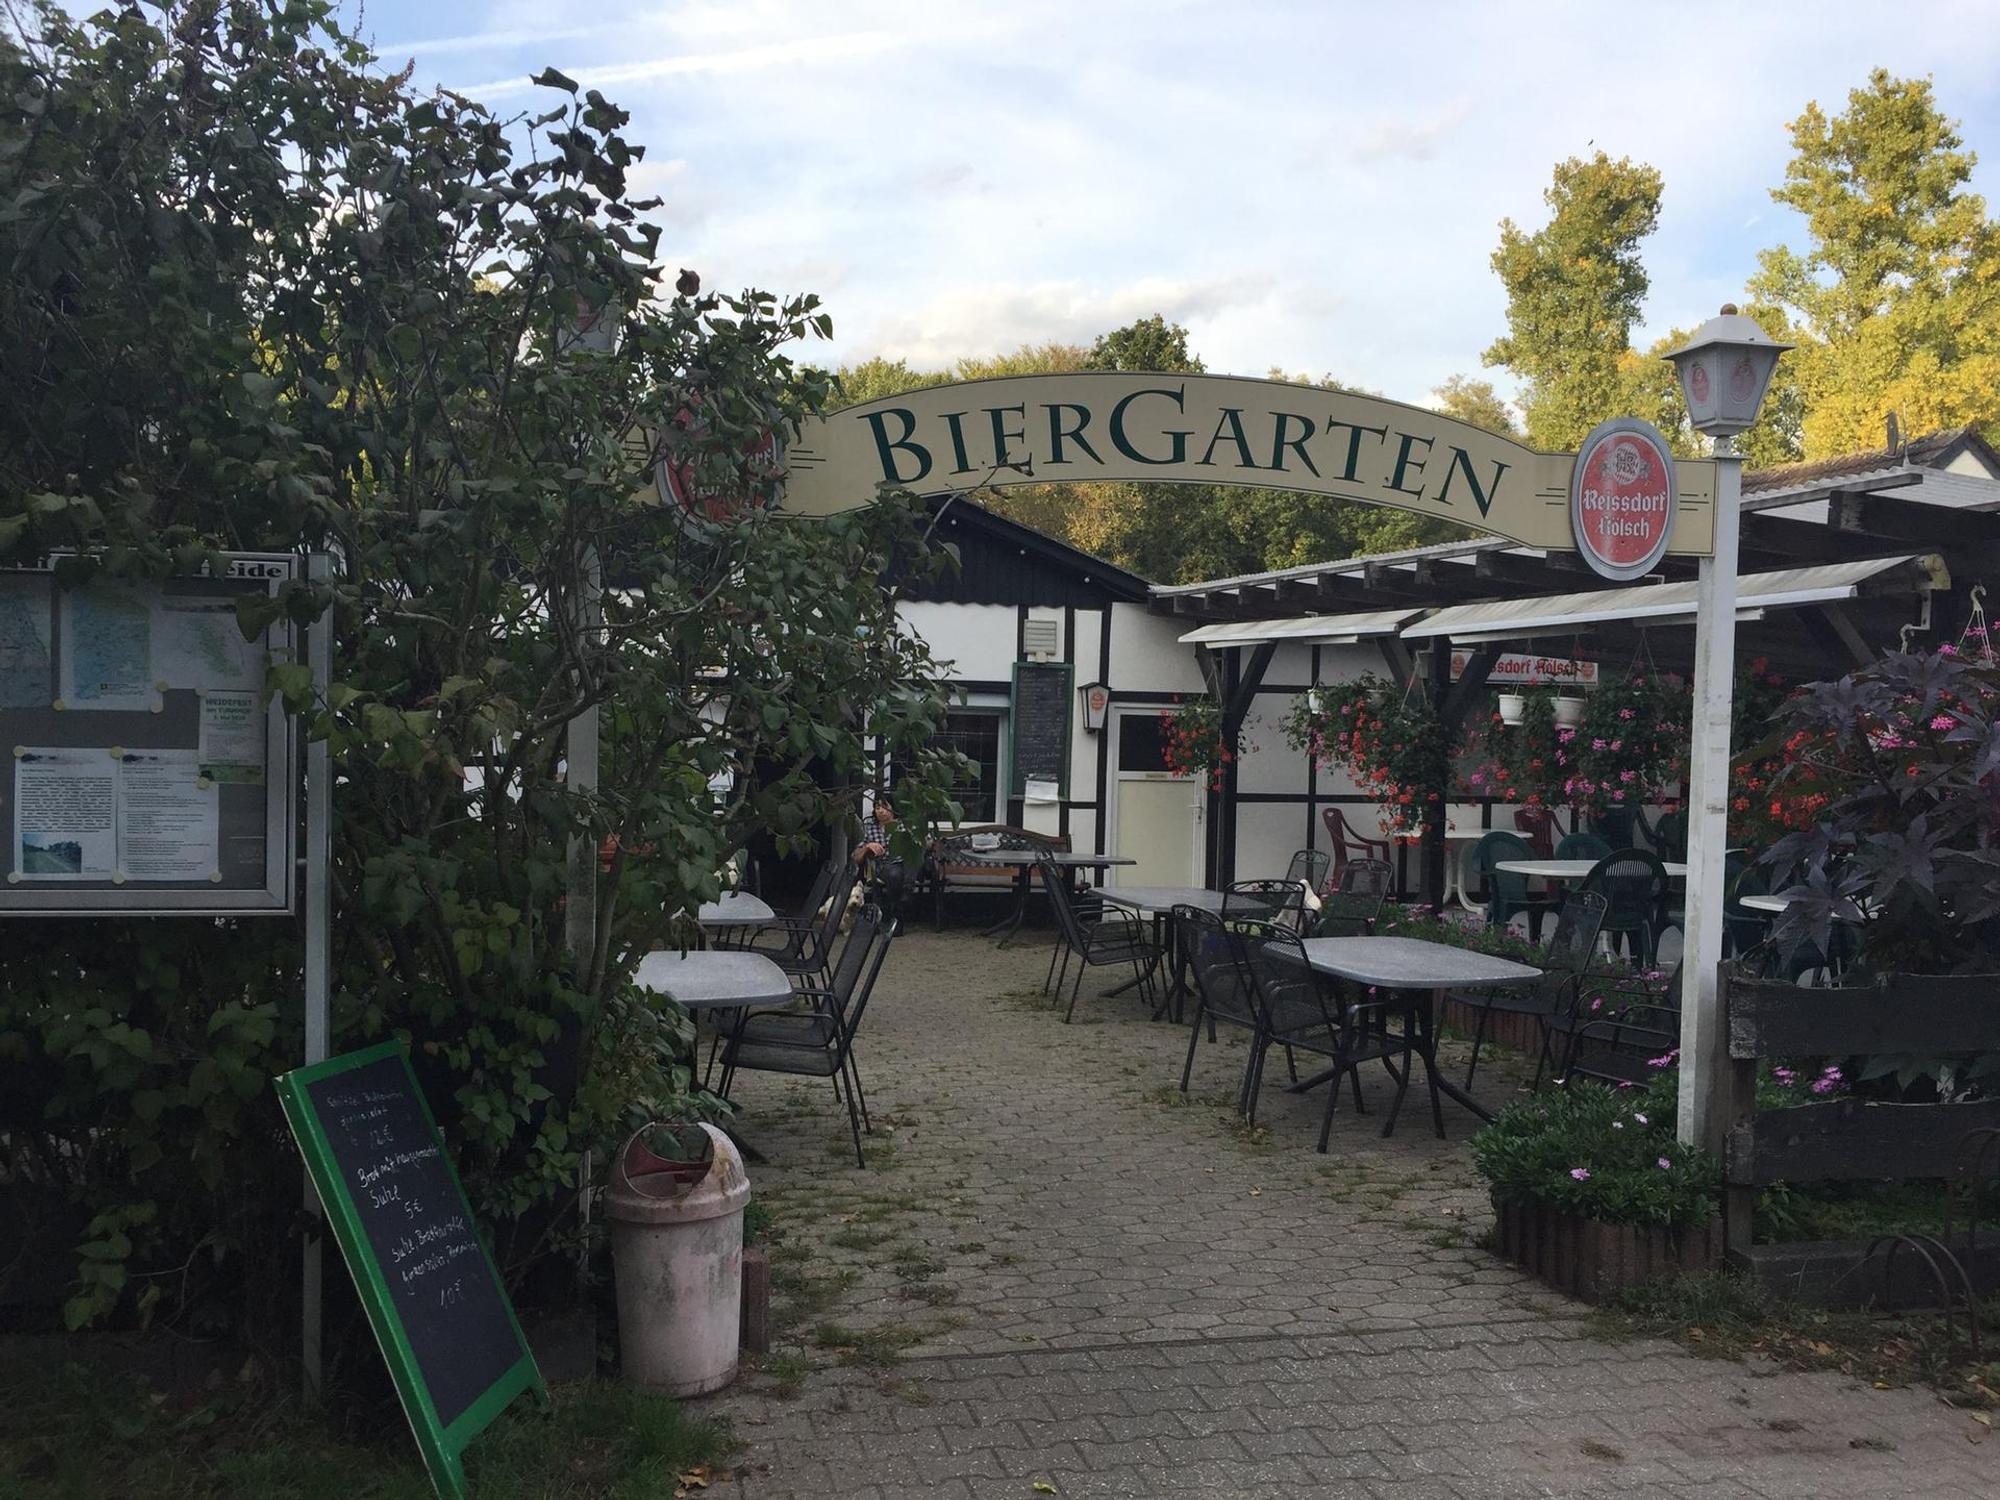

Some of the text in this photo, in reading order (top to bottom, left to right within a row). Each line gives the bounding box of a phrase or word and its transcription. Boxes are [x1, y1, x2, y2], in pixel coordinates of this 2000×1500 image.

[1583, 488, 1668, 512] Reissdorf
[1598, 517, 1651, 540] Kölsch
[226, 563, 281, 578] eide
